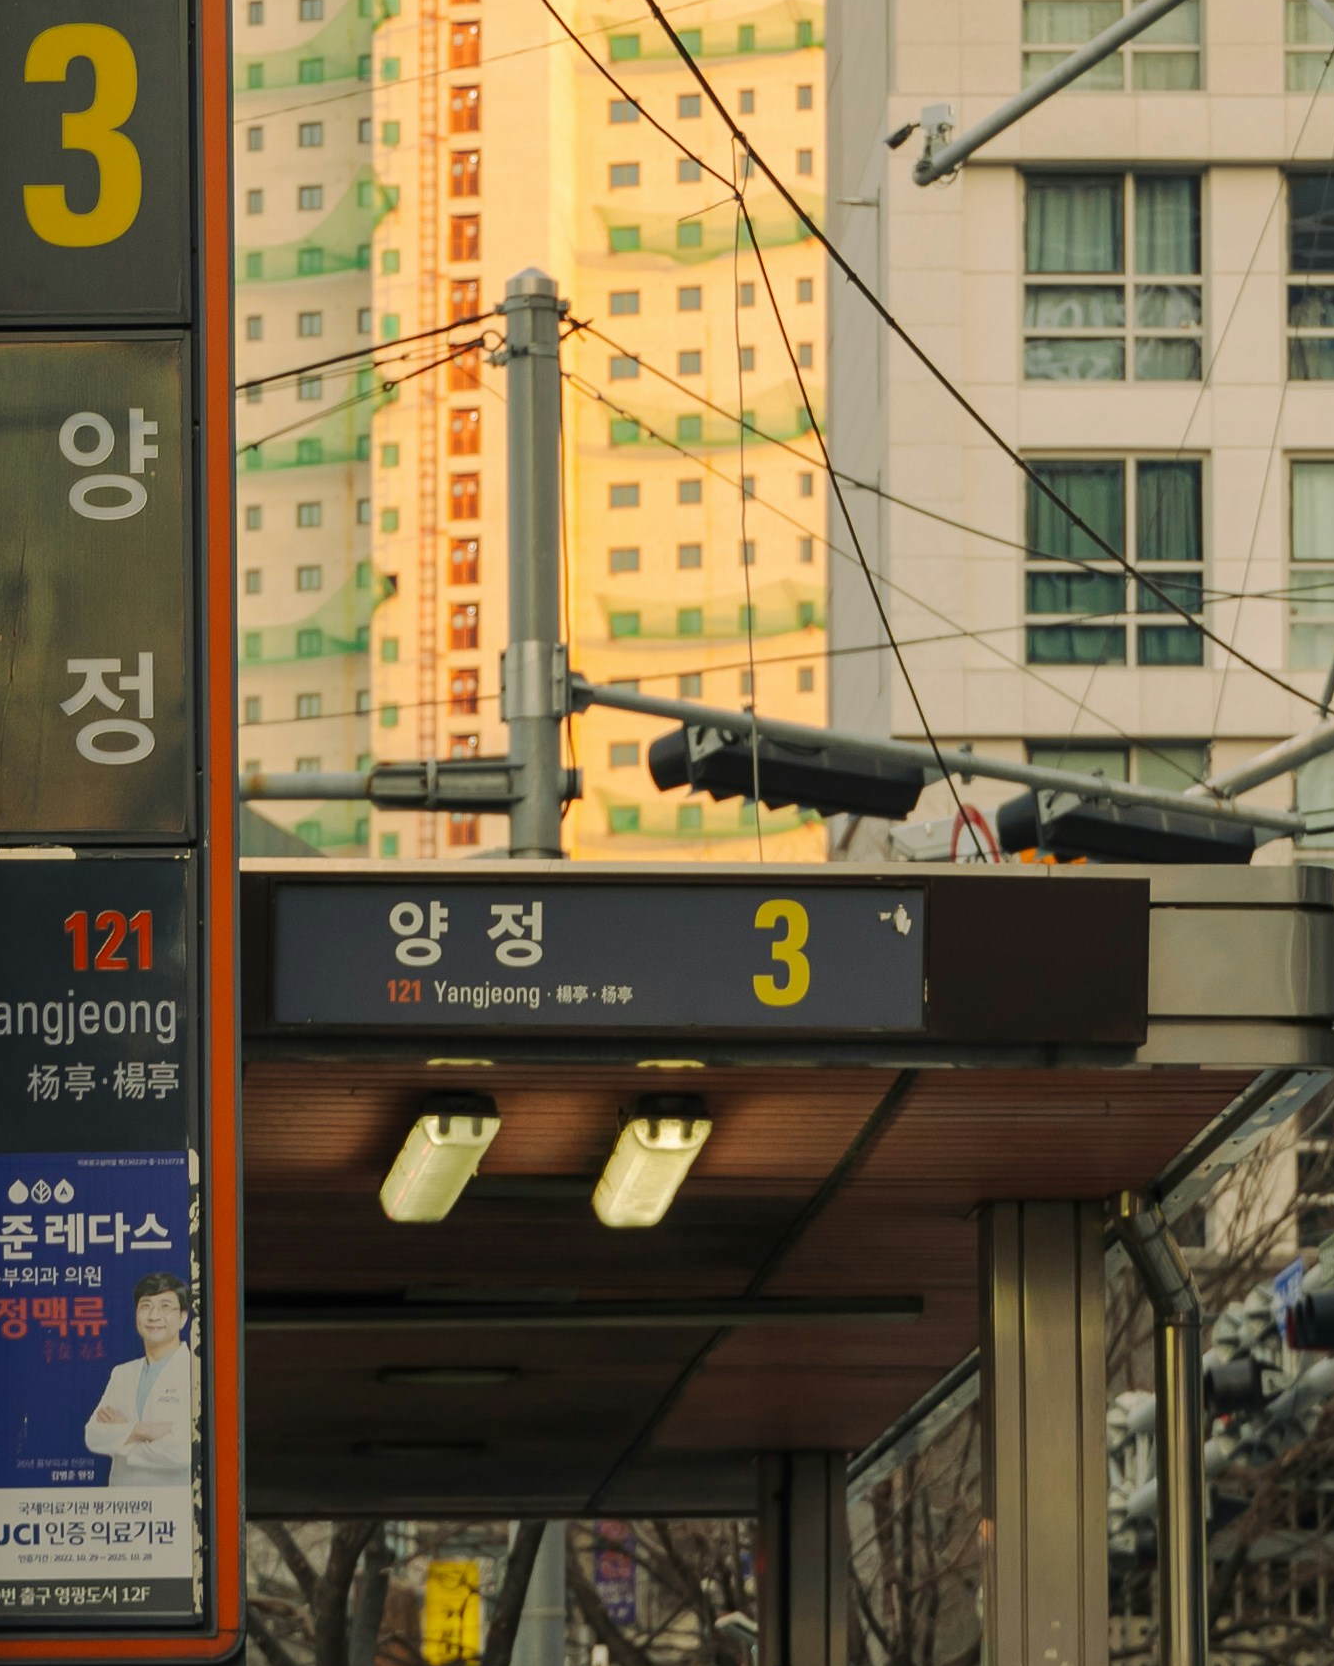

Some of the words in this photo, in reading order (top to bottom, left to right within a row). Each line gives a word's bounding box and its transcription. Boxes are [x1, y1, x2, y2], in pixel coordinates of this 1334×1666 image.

[23, 22, 143, 248] 3
[64, 910, 154, 972] 121
[752, 899, 811, 1008] 3
[387, 979, 422, 1003] 121
[433, 980, 541, 1009] Yangjeong
[44, 1212, 173, 1255] 레다스
[64, 1266, 102, 1288] 의원
[45, 1521, 87, 1547] 인증
[90, 1520, 176, 1546] 의료기관
[121, 1586, 152, 1603] 12F
